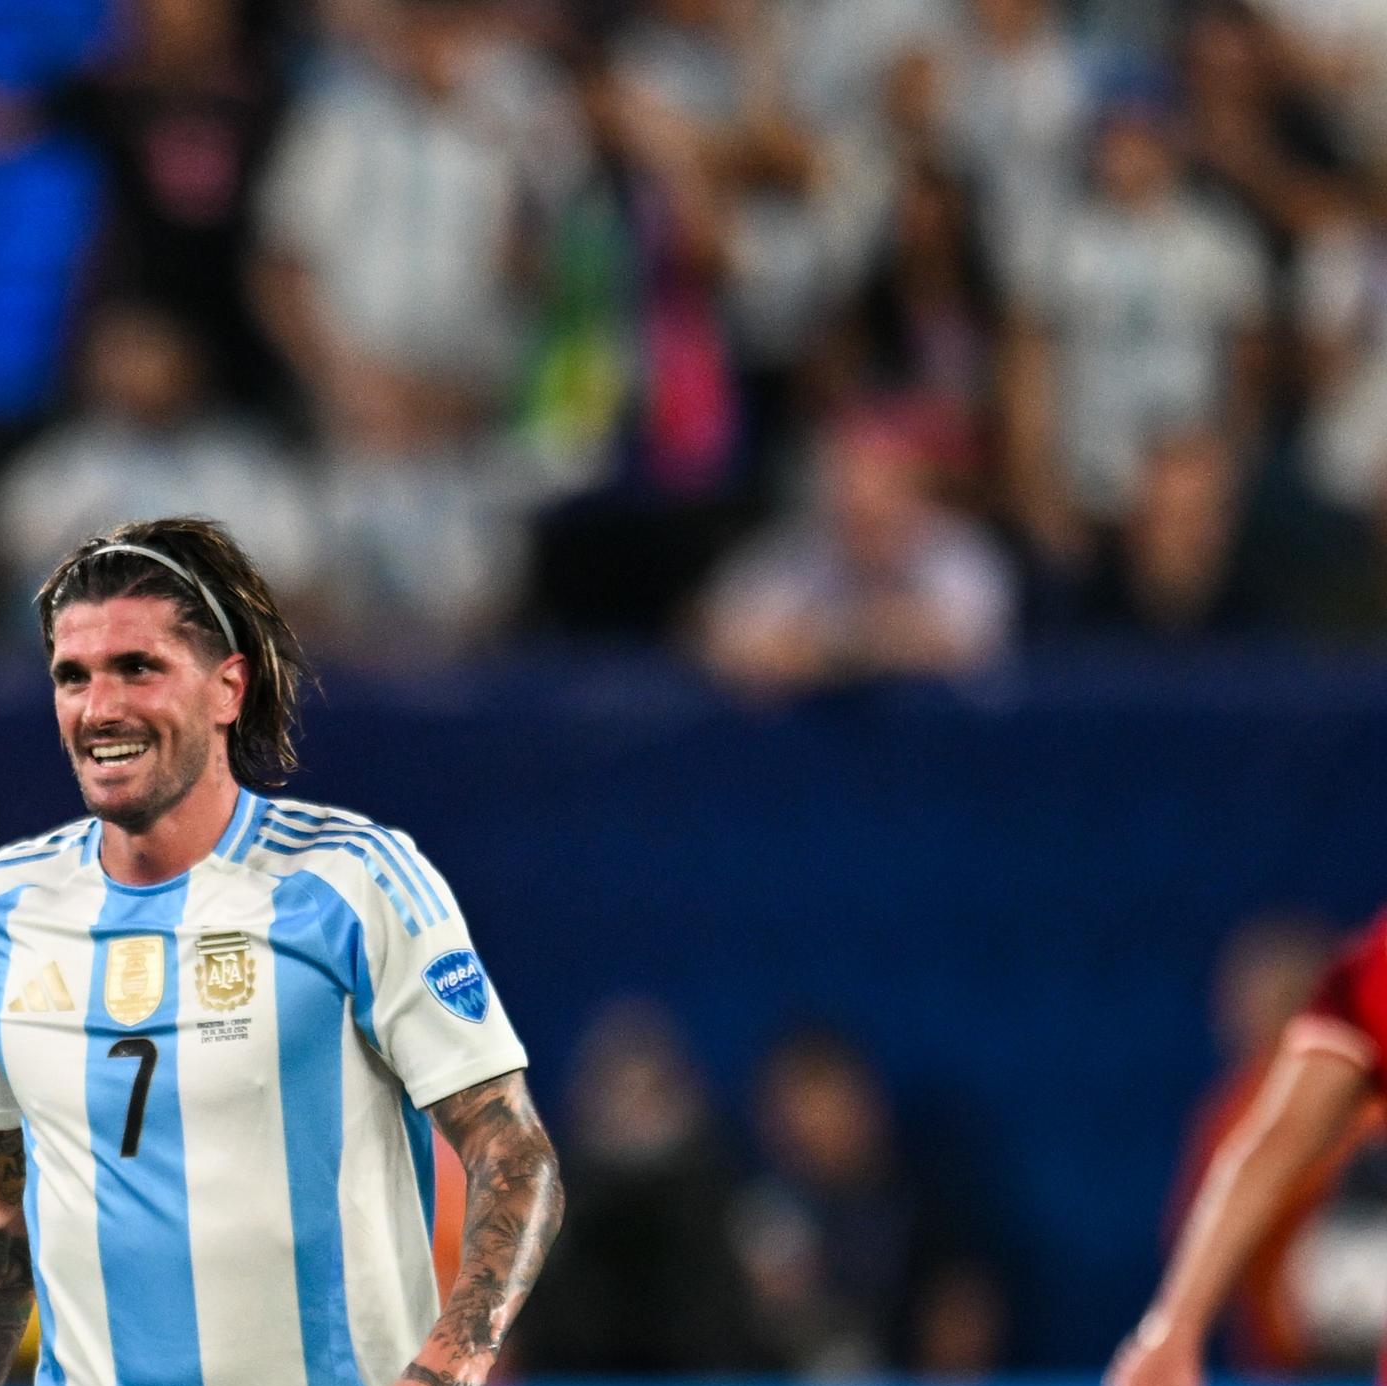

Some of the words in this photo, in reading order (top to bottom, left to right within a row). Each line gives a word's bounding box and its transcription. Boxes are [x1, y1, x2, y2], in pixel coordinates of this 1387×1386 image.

[207, 953, 243, 990] AFA
[435, 963, 478, 993] VIBRA
[106, 1037, 159, 1159] 7
